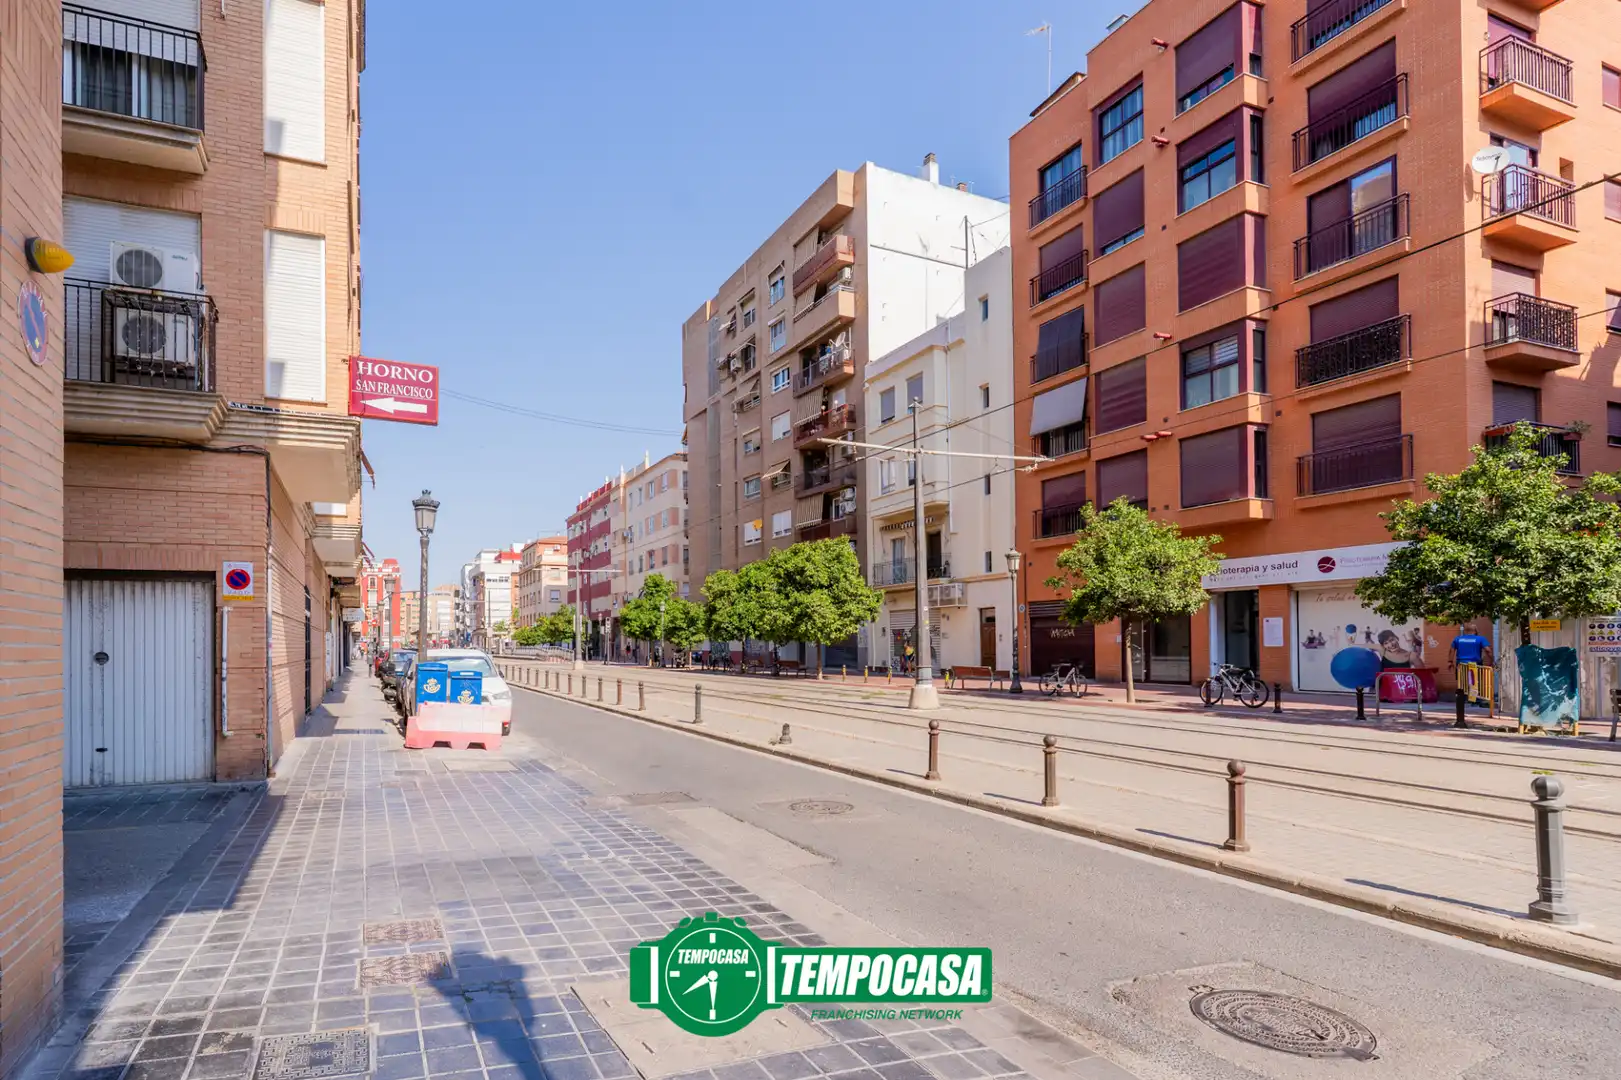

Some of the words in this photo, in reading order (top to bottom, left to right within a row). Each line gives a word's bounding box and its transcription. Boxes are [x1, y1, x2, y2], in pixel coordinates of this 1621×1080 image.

[356, 360, 434, 383] HORNO
[355, 379, 376, 392] SAN
[377, 381, 433, 399] FRANCISCO
[1262, 564, 1269, 573] y
[1270, 560, 1299, 571] salud
